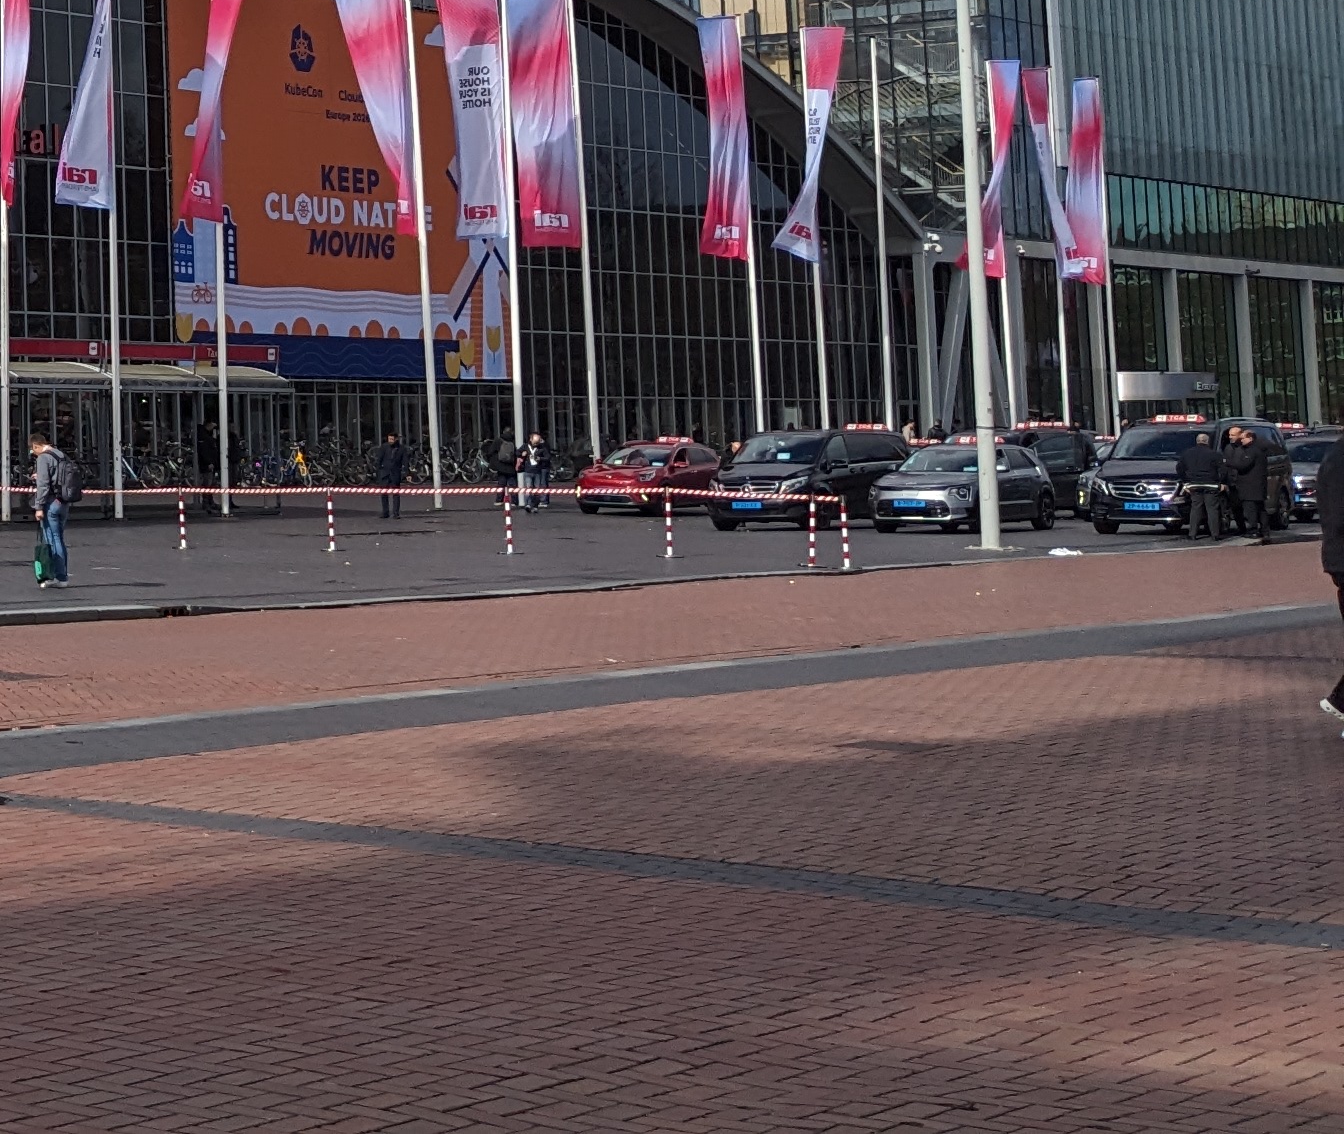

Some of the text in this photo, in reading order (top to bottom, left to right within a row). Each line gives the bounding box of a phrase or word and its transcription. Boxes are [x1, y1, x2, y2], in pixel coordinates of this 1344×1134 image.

[284, 82, 323, 98] KubeCon
[325, 109, 351, 122] Europe
[320, 164, 380, 195] KEEP
[264, 191, 346, 225] CLOUD
[352, 199, 433, 232] NATE
[305, 228, 396, 260] MOVING
